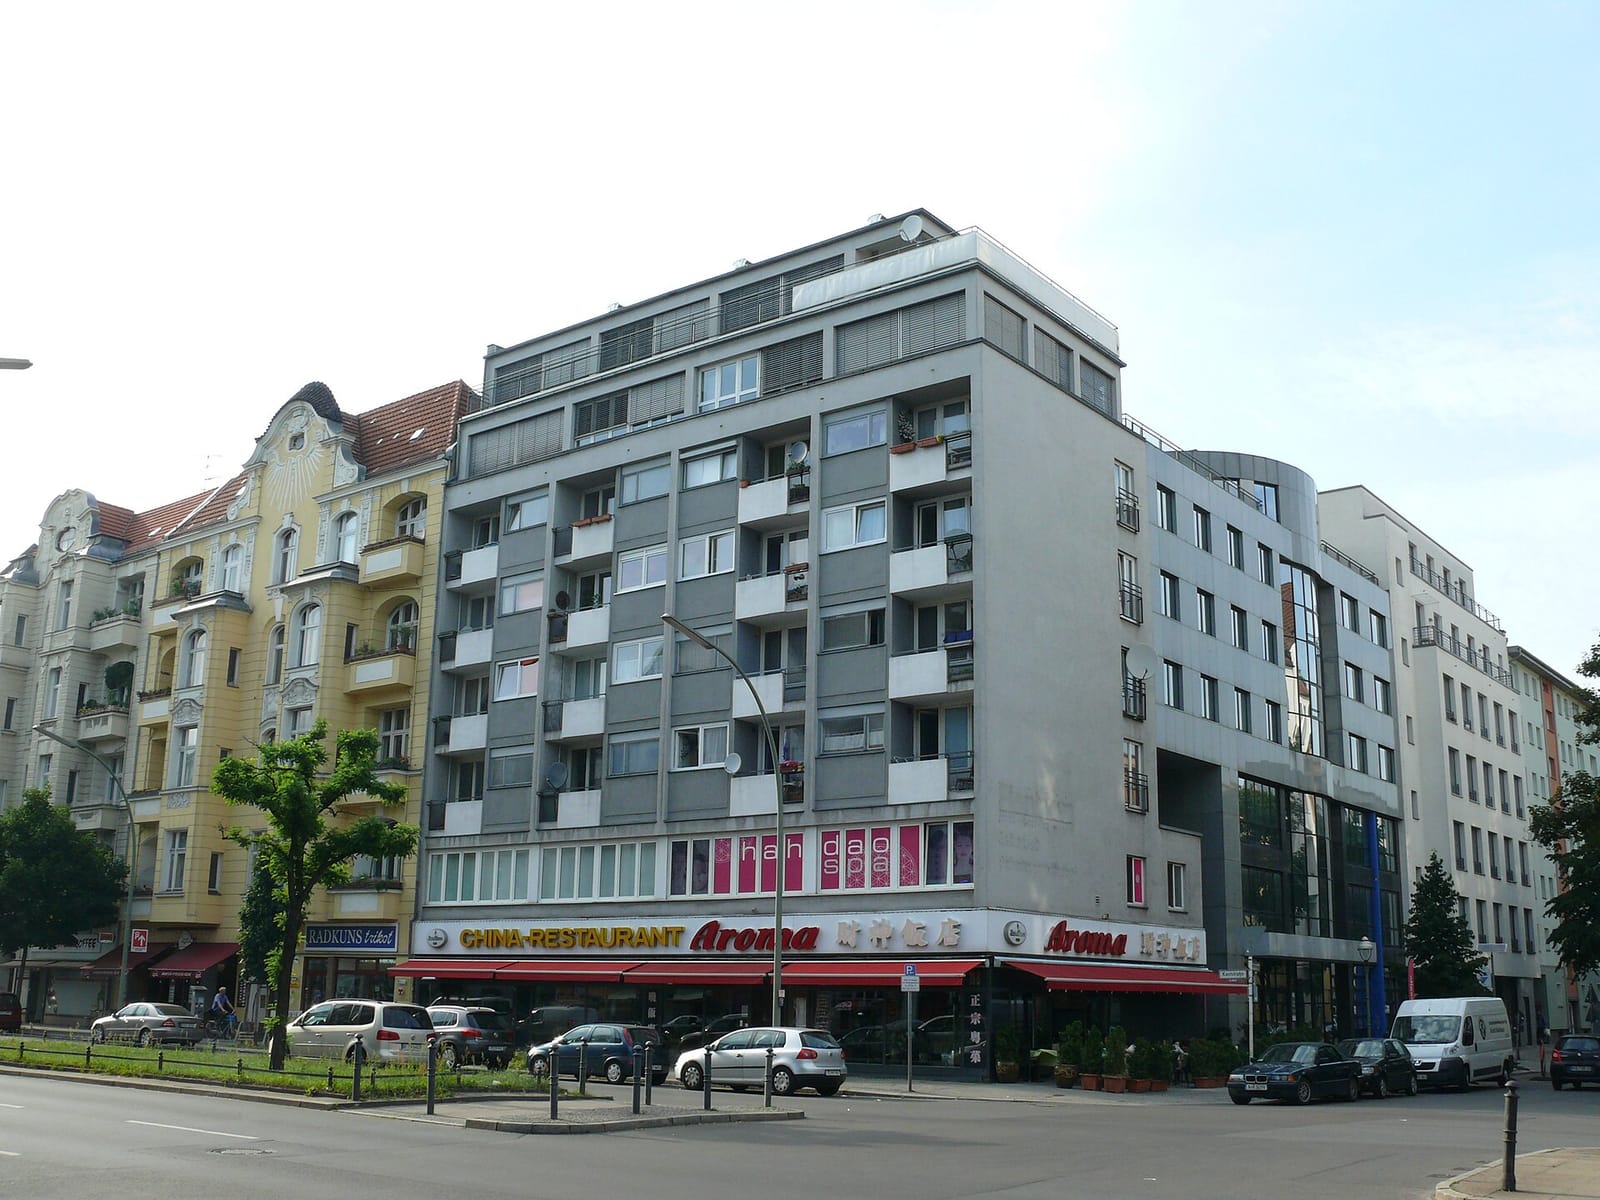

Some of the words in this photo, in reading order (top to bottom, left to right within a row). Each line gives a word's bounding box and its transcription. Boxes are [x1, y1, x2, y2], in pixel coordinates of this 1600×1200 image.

[823, 834, 889, 856] dao
[823, 856, 888, 877] spa
[308, 929, 363, 945] RADKUNS
[364, 929, 395, 945] trikot
[459, 926, 685, 949] CHINA-RESTAURANT
[690, 920, 820, 952] Aroma
[1044, 920, 1128, 956] Aroma
[906, 965, 913, 975] P
